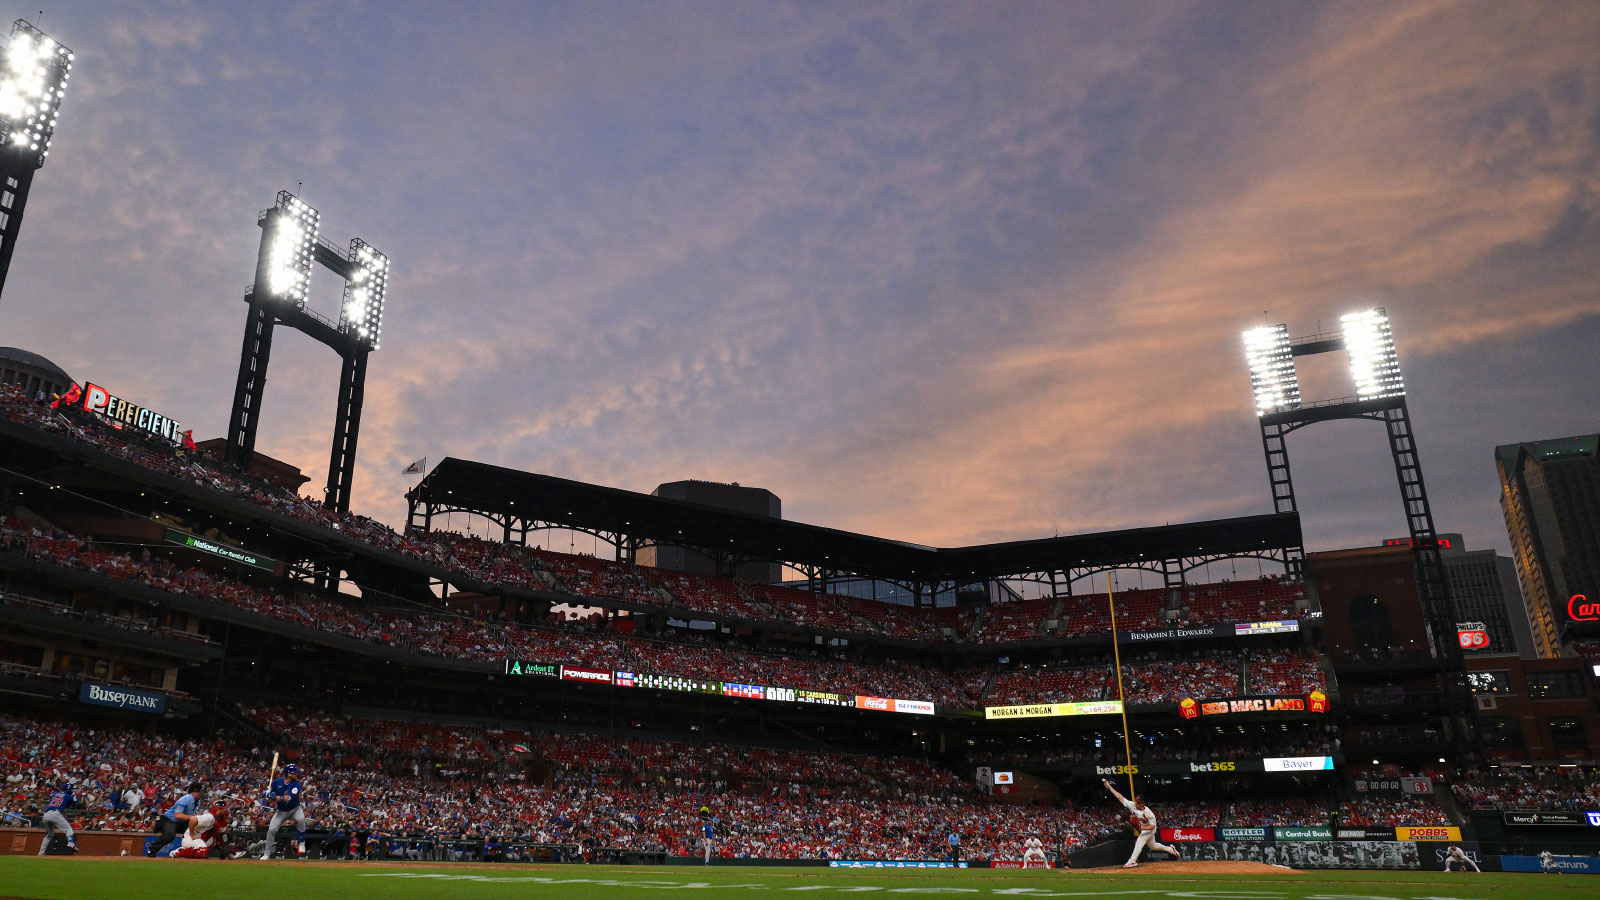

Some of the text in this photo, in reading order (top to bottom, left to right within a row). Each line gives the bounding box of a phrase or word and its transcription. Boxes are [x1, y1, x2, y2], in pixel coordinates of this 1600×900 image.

[84, 384, 180, 440] PERFICIENT
[193, 540, 218, 553] National
[228, 551, 245, 561] Rental
[245, 556, 256, 564] Club
[1131, 629, 1212, 640] BENJAMIN F. EDWARDS
[1461, 633, 1484, 646] 66
[526, 664, 555, 673] Ardent IT
[564, 669, 611, 681] POWERADE
[992, 708, 1018, 716] MORGAN
[1026, 706, 1052, 715] MORGAN
[1230, 700, 1264, 712] MAC
[1265, 699, 1304, 710] LAND
[1190, 761, 1236, 772] bet365
[1283, 760, 1313, 769] Bayer
[1370, 781, 1399, 789] GO GO GO
[1286, 830, 1332, 838] Central Bank
